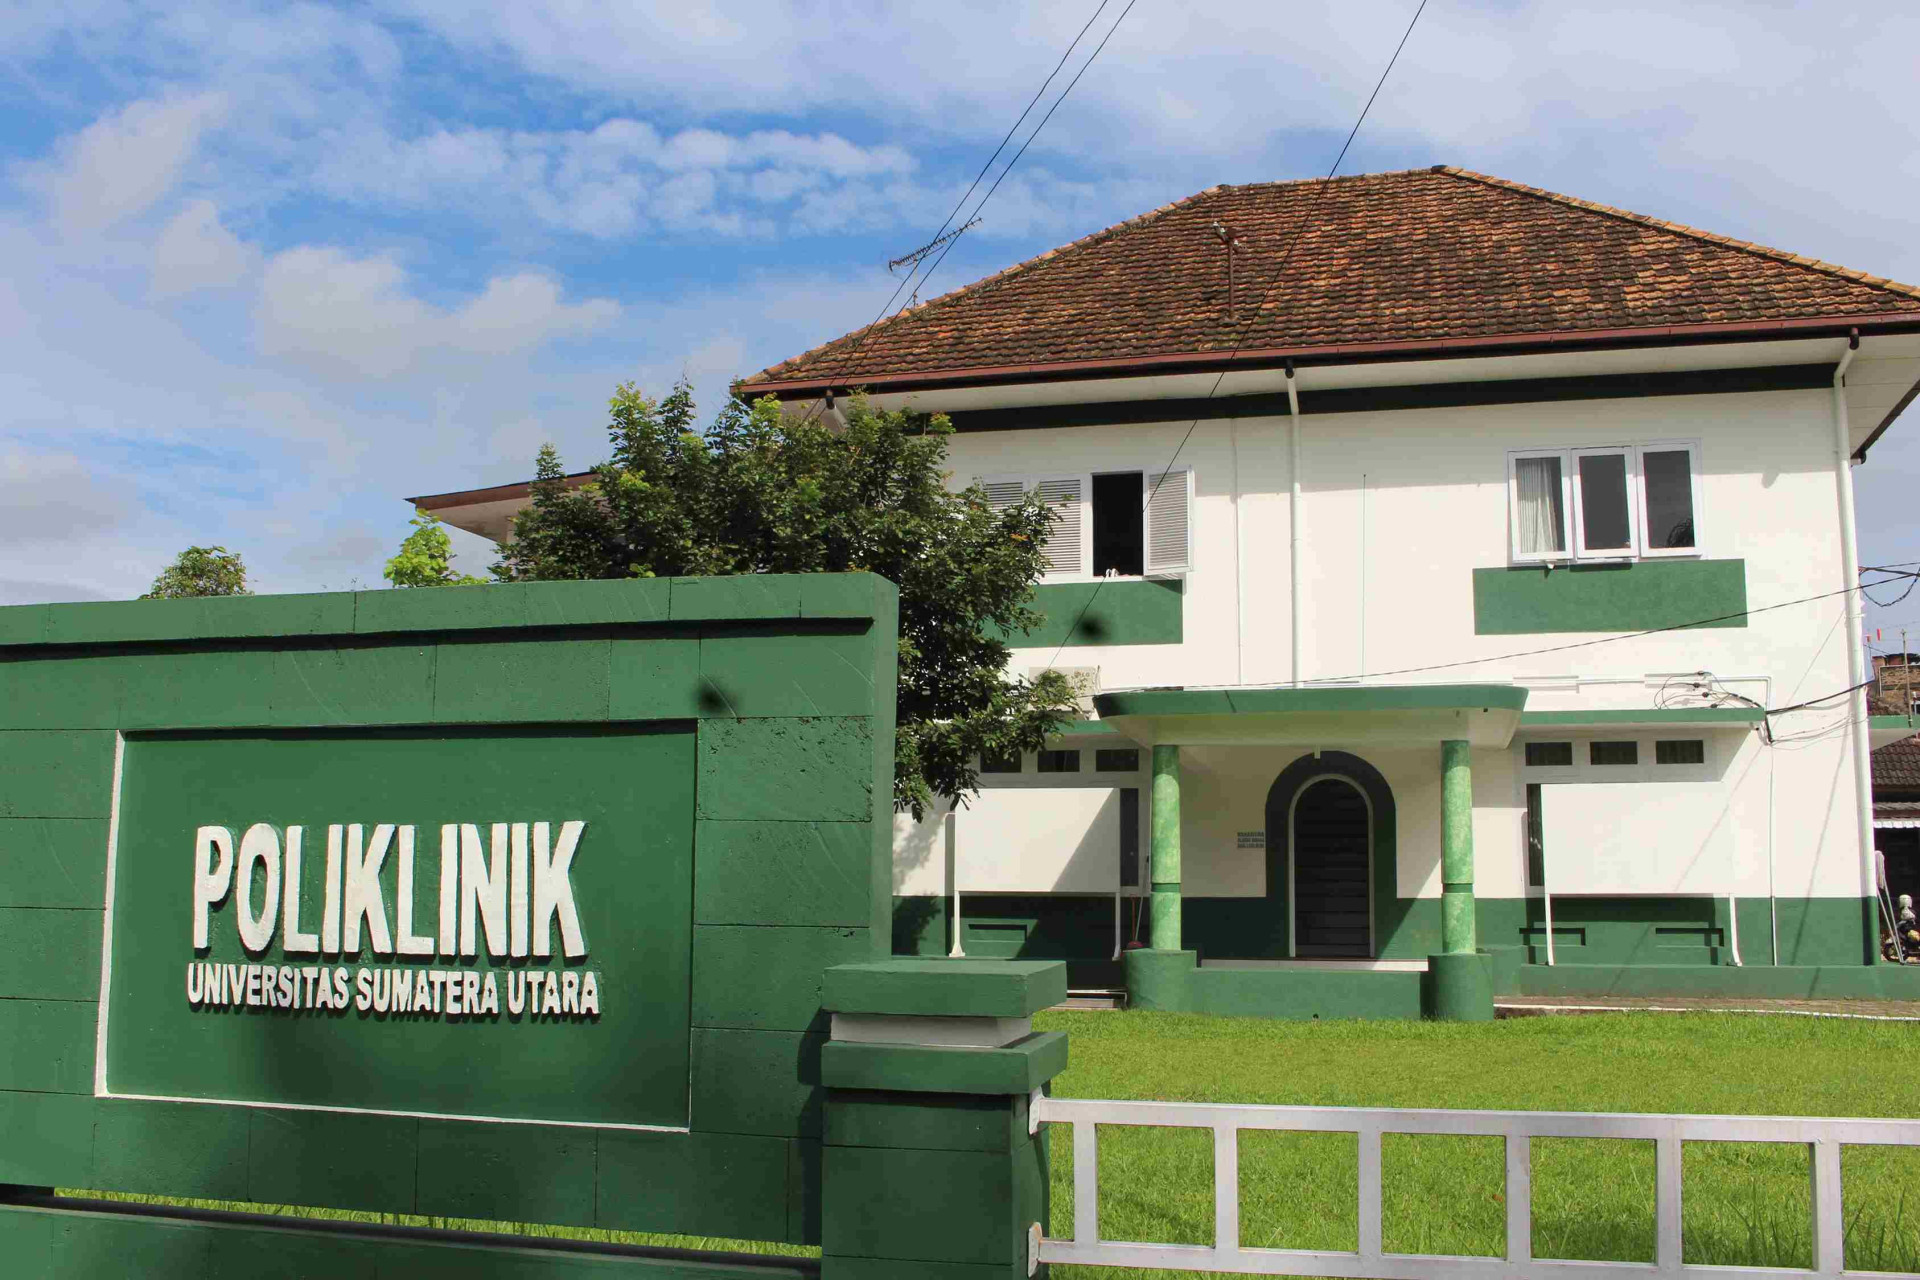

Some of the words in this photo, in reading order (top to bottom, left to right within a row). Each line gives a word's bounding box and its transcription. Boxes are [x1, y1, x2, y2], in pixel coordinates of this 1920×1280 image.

[192, 821, 587, 957] POLIKLINIK
[187, 963, 351, 1010] UNIVERSITAS
[356, 967, 499, 1015] SUMATERA
[507, 970, 601, 1015] UTARA
